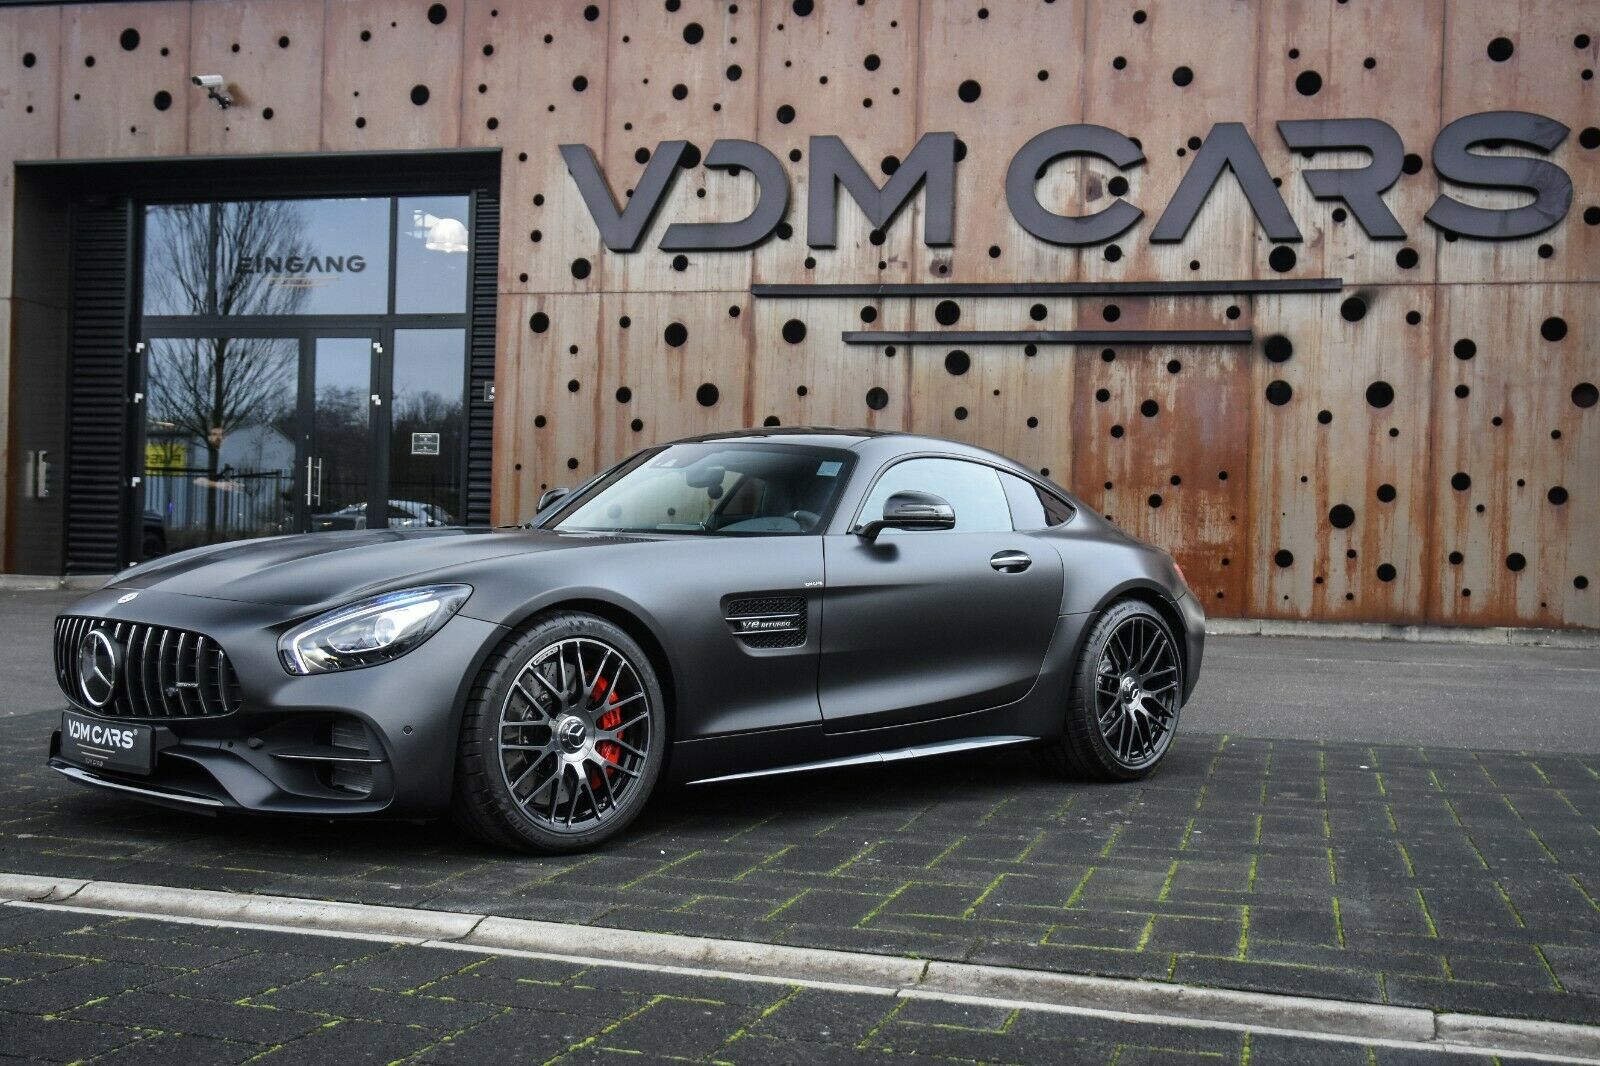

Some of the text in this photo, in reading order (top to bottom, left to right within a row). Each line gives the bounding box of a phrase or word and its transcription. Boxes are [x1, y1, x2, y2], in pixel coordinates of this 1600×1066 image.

[558, 111, 1573, 253] VDM CARS
[236, 255, 367, 273] EINGANG
[68, 719, 91, 742] VDM
